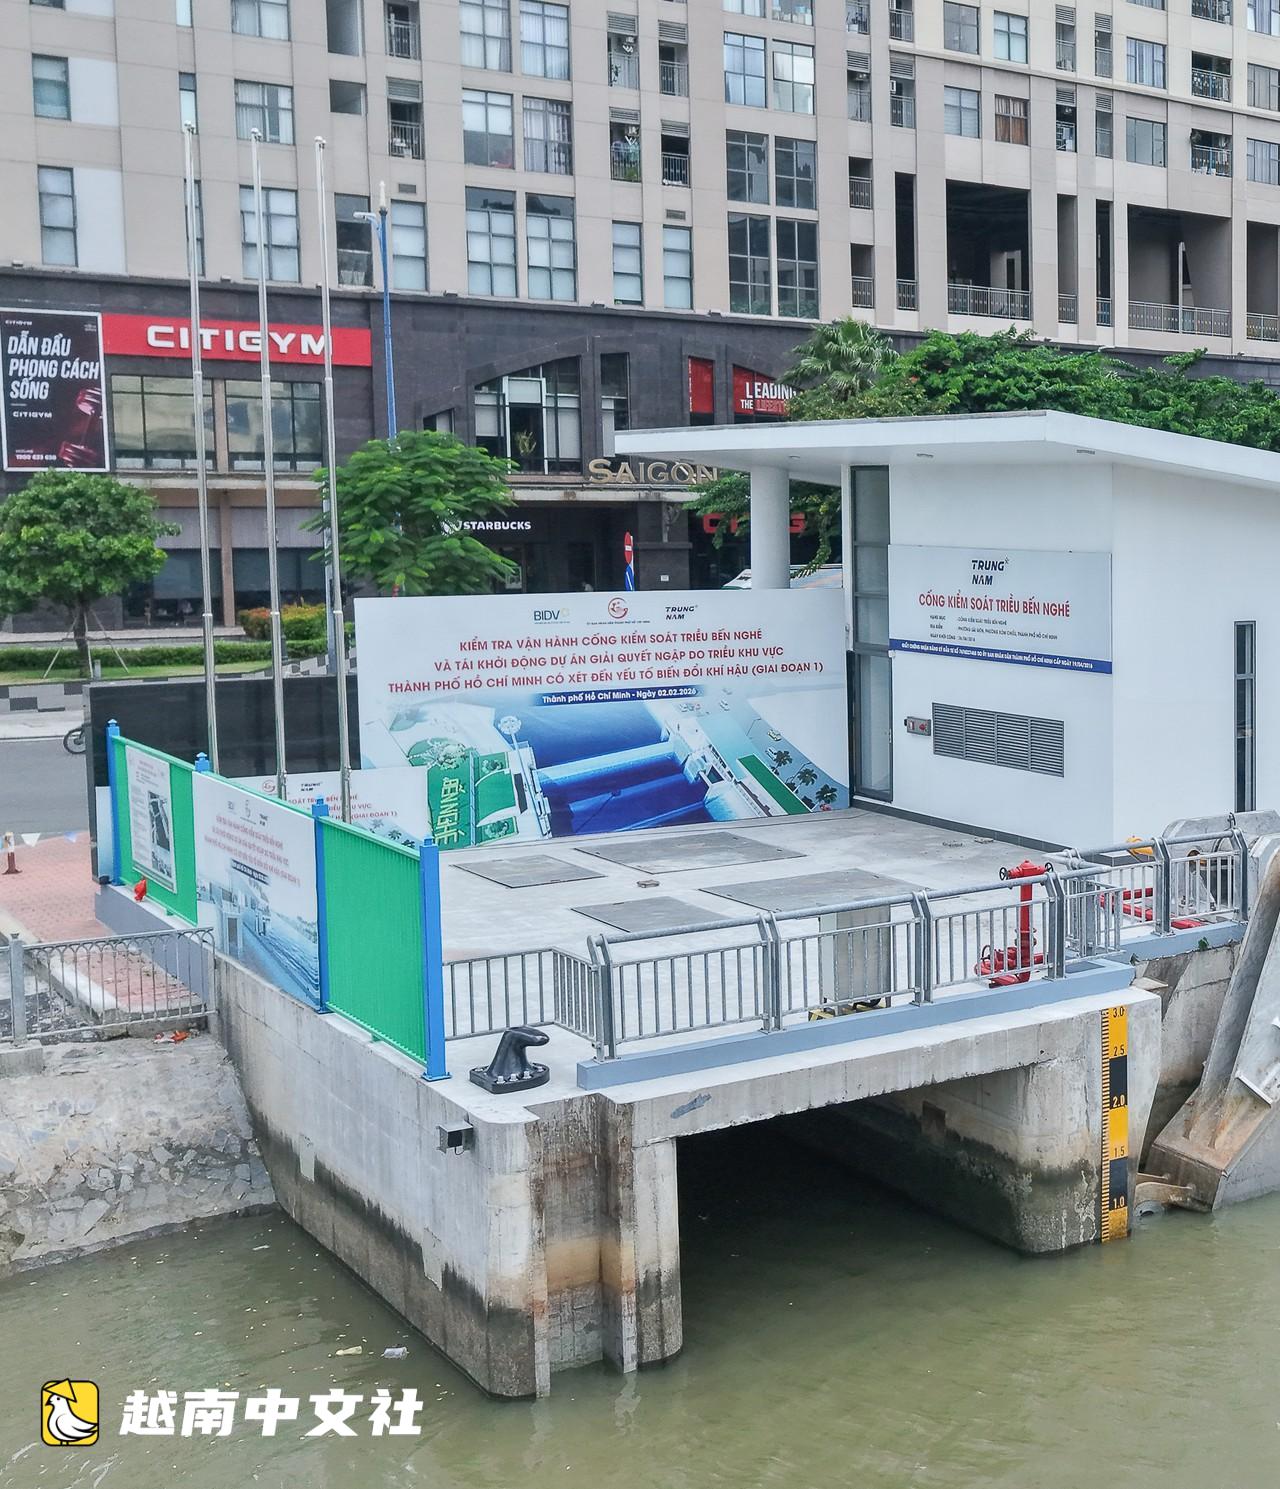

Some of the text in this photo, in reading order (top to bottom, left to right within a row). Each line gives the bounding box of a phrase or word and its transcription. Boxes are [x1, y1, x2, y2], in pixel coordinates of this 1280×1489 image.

[8, 330, 39, 356] DẪN
[147, 325, 333, 356] CITIGYM
[9, 357, 100, 380] PHONG CÁCH
[10, 377, 50, 400] SỐNG
[745, 381, 797, 400] LEADIN
[588, 458, 718, 484] SAIGON
[463, 521, 532, 530] STARBUCKS
[971, 559, 1005, 571] TRUNG
[971, 574, 993, 586] NAM
[665, 605, 695, 613] TRUNG
[919, 589, 1071, 618] CỐNG KIỂM SOÁT TRIỀU BẾN NGHÉ
[533, 609, 561, 621] BIDV
[460, 628, 762, 651] KIỂM TRA VẬN HÀNH CỐNG KIỂM SOÁT TRIỀU BẾN NGHÉ
[434, 645, 784, 671] VÀ TÁI KHỞI ĐỘNG DỰ ÁN GIẢI QUYẾT NGẬP DO TRIỀU KHU VỰC
[388, 662, 824, 693] THÀNH PHỐ HỒ CHÍ MINH CÓ XÉT ĐẾN YẾU TỐ BIẾN ĐỔI KHÍ HẬU (GIAI ĐOẠN 1)
[542, 694, 567, 704] Thành
[568, 692, 583, 703] phố
[584, 692, 596, 701] Hồ
[598, 692, 611, 700] Chí
[612, 691, 631, 699] Minh
[637, 689, 656, 699] Ngày
[657, 687, 697, 697] 02.02.2026
[1113, 1006, 1125, 1018] 3.0
[1113, 1094, 1125, 1108] 2.0
[1114, 1146, 1125, 1158] 1.5
[1113, 1196, 1125, 1209] 1.0
